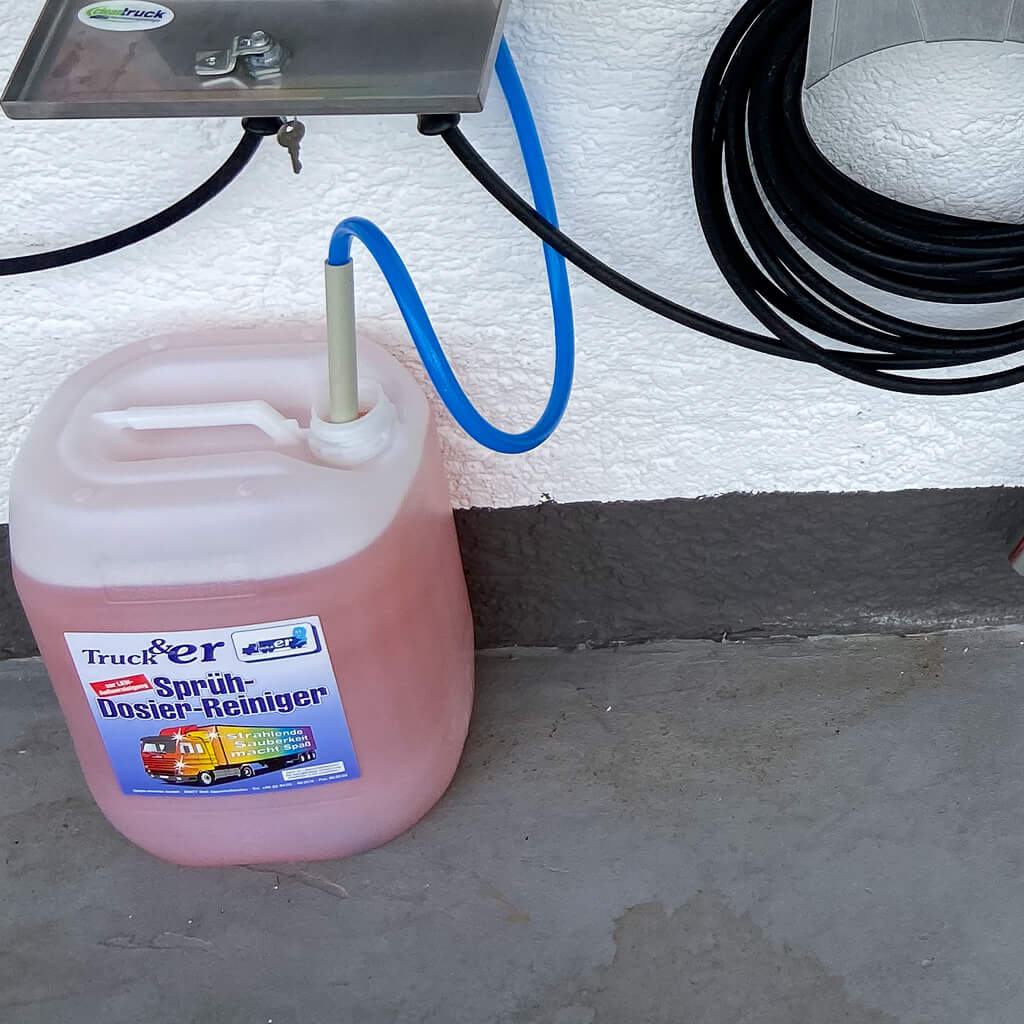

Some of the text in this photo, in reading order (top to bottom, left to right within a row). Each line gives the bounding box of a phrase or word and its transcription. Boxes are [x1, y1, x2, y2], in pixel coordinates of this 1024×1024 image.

[153, 673, 254, 701] Sprüh-
[97, 686, 328, 720] Dosier-Reiniger
[231, 745, 280, 758] macht
